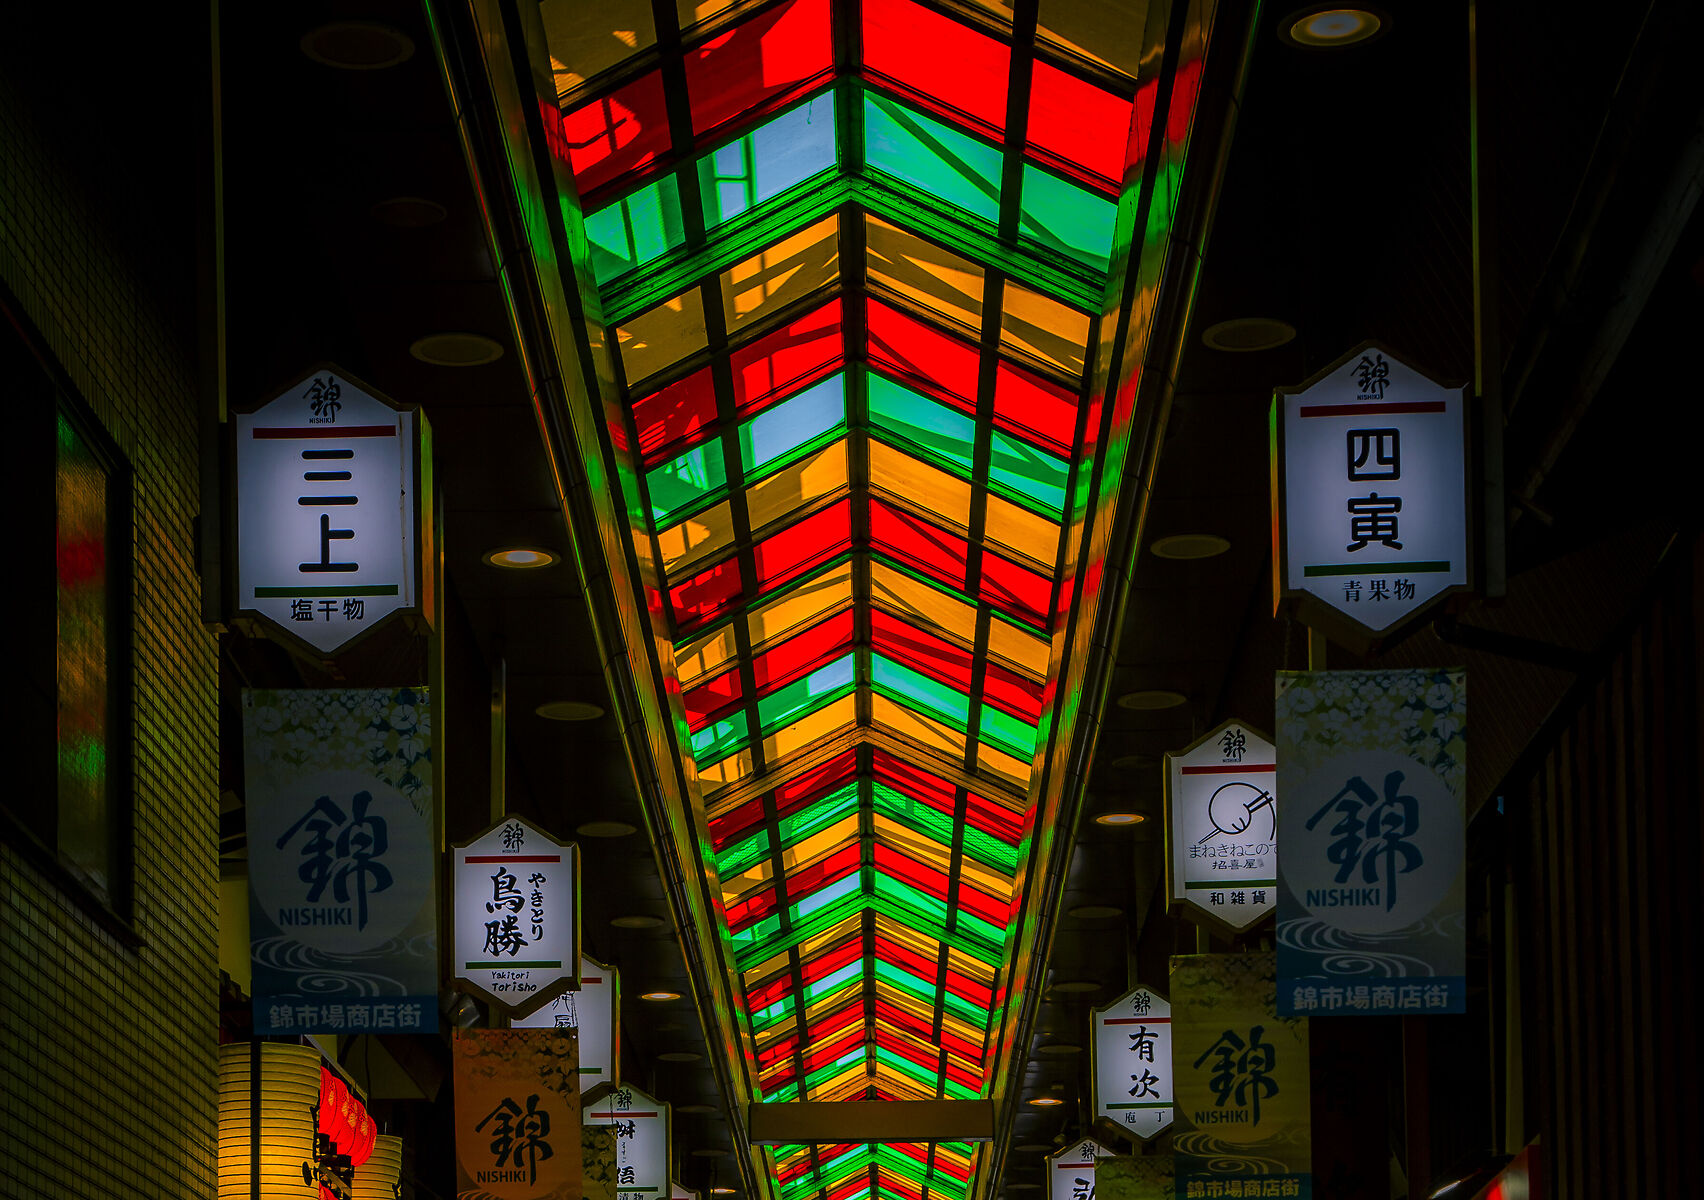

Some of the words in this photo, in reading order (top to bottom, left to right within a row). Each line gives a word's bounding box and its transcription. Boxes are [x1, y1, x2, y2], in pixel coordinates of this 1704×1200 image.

[1350, 354, 1390, 399] 錦
[303, 376, 341, 423] 錦
[1347, 428, 1402, 552] 四寅
[298, 449, 359, 573] 三上
[1342, 579, 1416, 602] 青果物
[291, 598, 364, 621] 塩干物
[1218, 729, 1246, 762] 錦
[499, 823, 524, 853] 錦
[1305, 770, 1424, 913] 錦
[276, 790, 393, 932] 錦
[483, 867, 529, 957] 鳥勝
[528, 872, 546, 941] やきとり
[1210, 891, 1266, 906] 和雑貨
[1306, 889, 1380, 907] NISHIKI
[279, 907, 352, 926] NISHIKI
[491, 971, 530, 980] Yakitori
[1130, 992, 1150, 1016] 錦
[1293, 984, 1449, 1011] 錦市場商店街
[268, 1002, 422, 1029] 錦市場商店街
[1128, 1026, 1160, 1099] 有次
[1193, 1025, 1279, 1127] 錦
[1195, 1110, 1248, 1124] NISHIKI
[475, 1094, 554, 1187] 錦
[477, 1171, 526, 1183] NISHIKI
[1185, 1178, 1300, 1199] 錦市場商店街
